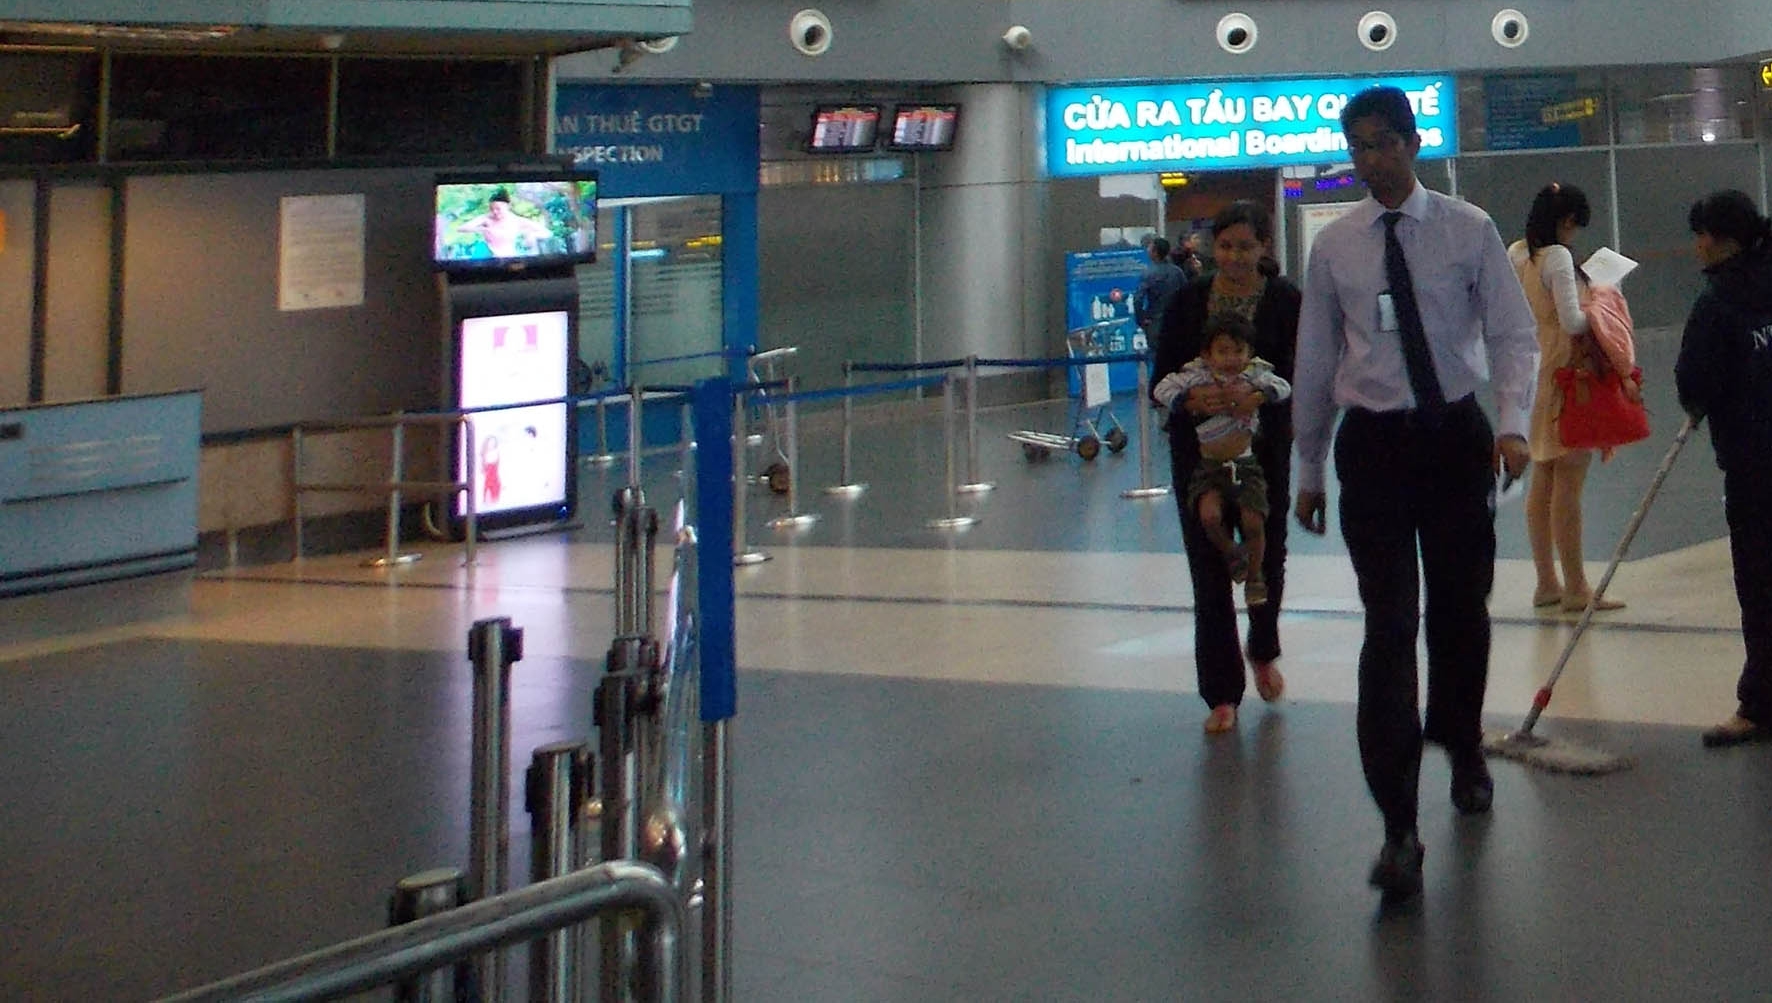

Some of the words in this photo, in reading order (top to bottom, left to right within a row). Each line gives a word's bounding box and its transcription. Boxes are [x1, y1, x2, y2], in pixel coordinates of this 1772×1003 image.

[648, 113, 704, 134] GTGT
[1136, 100, 1181, 127] RA
[1253, 95, 1312, 122] BAY
[558, 144, 663, 164] SPECTION
[1066, 130, 1240, 165] International
[1246, 126, 1349, 156] Boardin
